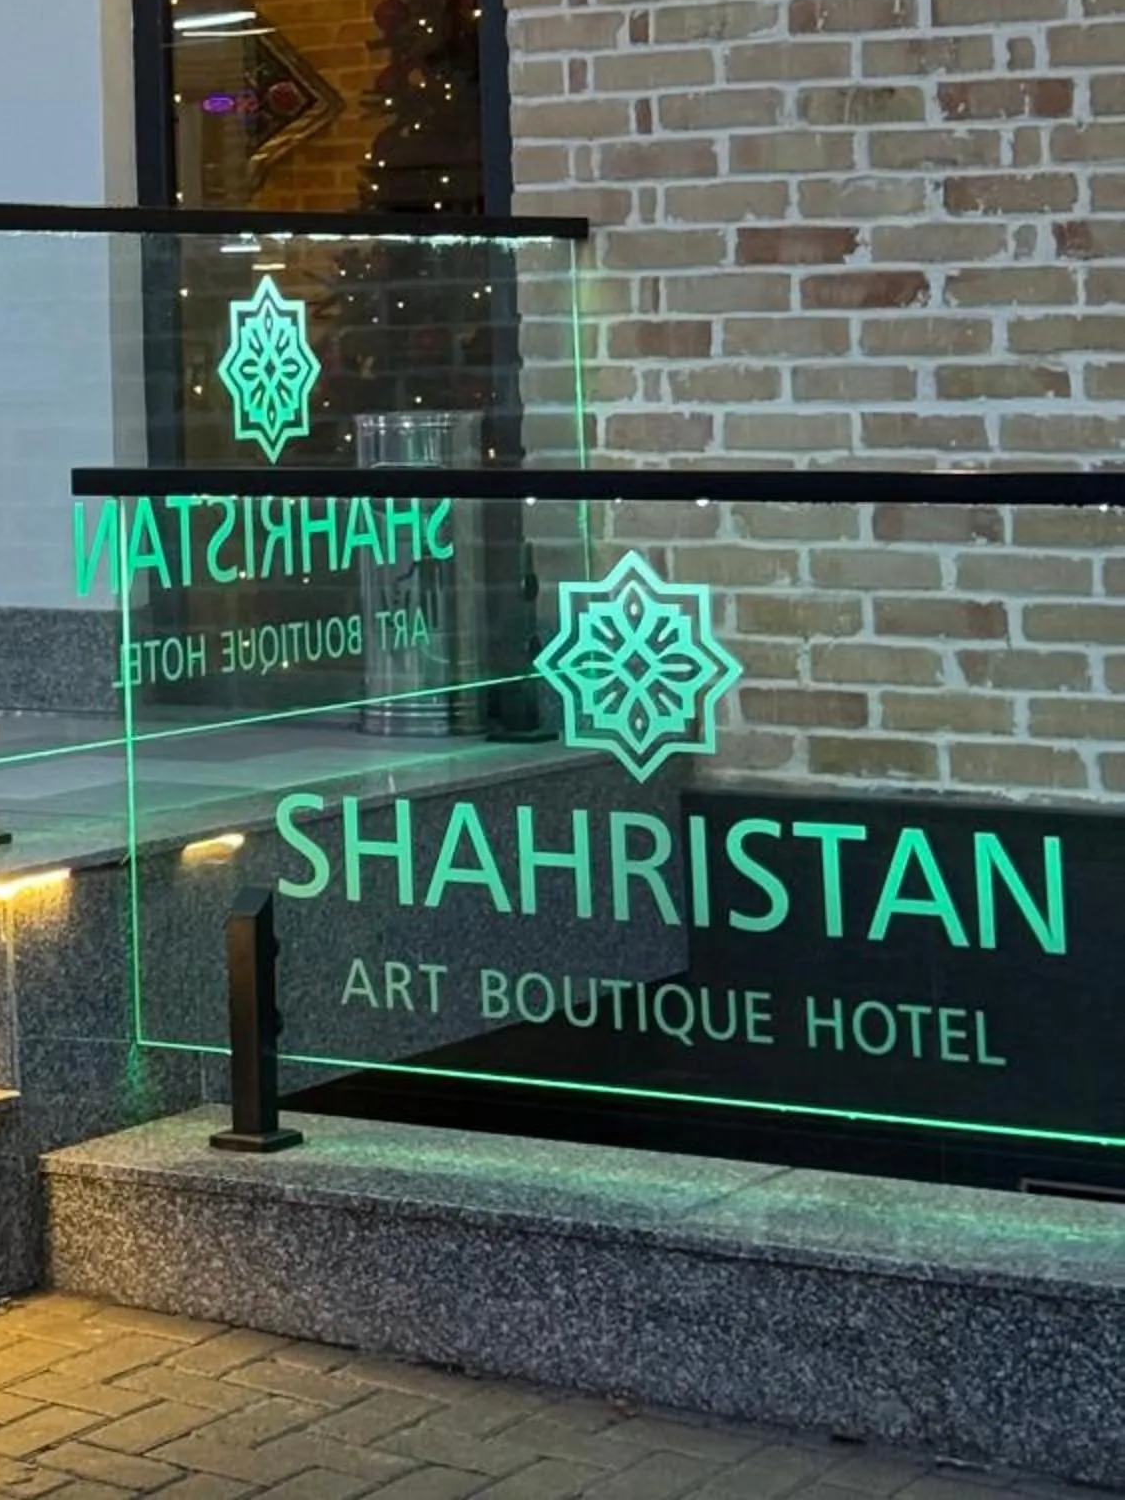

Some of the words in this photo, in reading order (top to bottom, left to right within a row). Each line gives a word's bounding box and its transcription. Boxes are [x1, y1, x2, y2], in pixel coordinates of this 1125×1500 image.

[276, 791, 1067, 955] SHAHRISTAN
[341, 958, 448, 1019] ART
[481, 969, 773, 1047] BOUTIQUE
[807, 997, 1006, 1067] HOTEL
